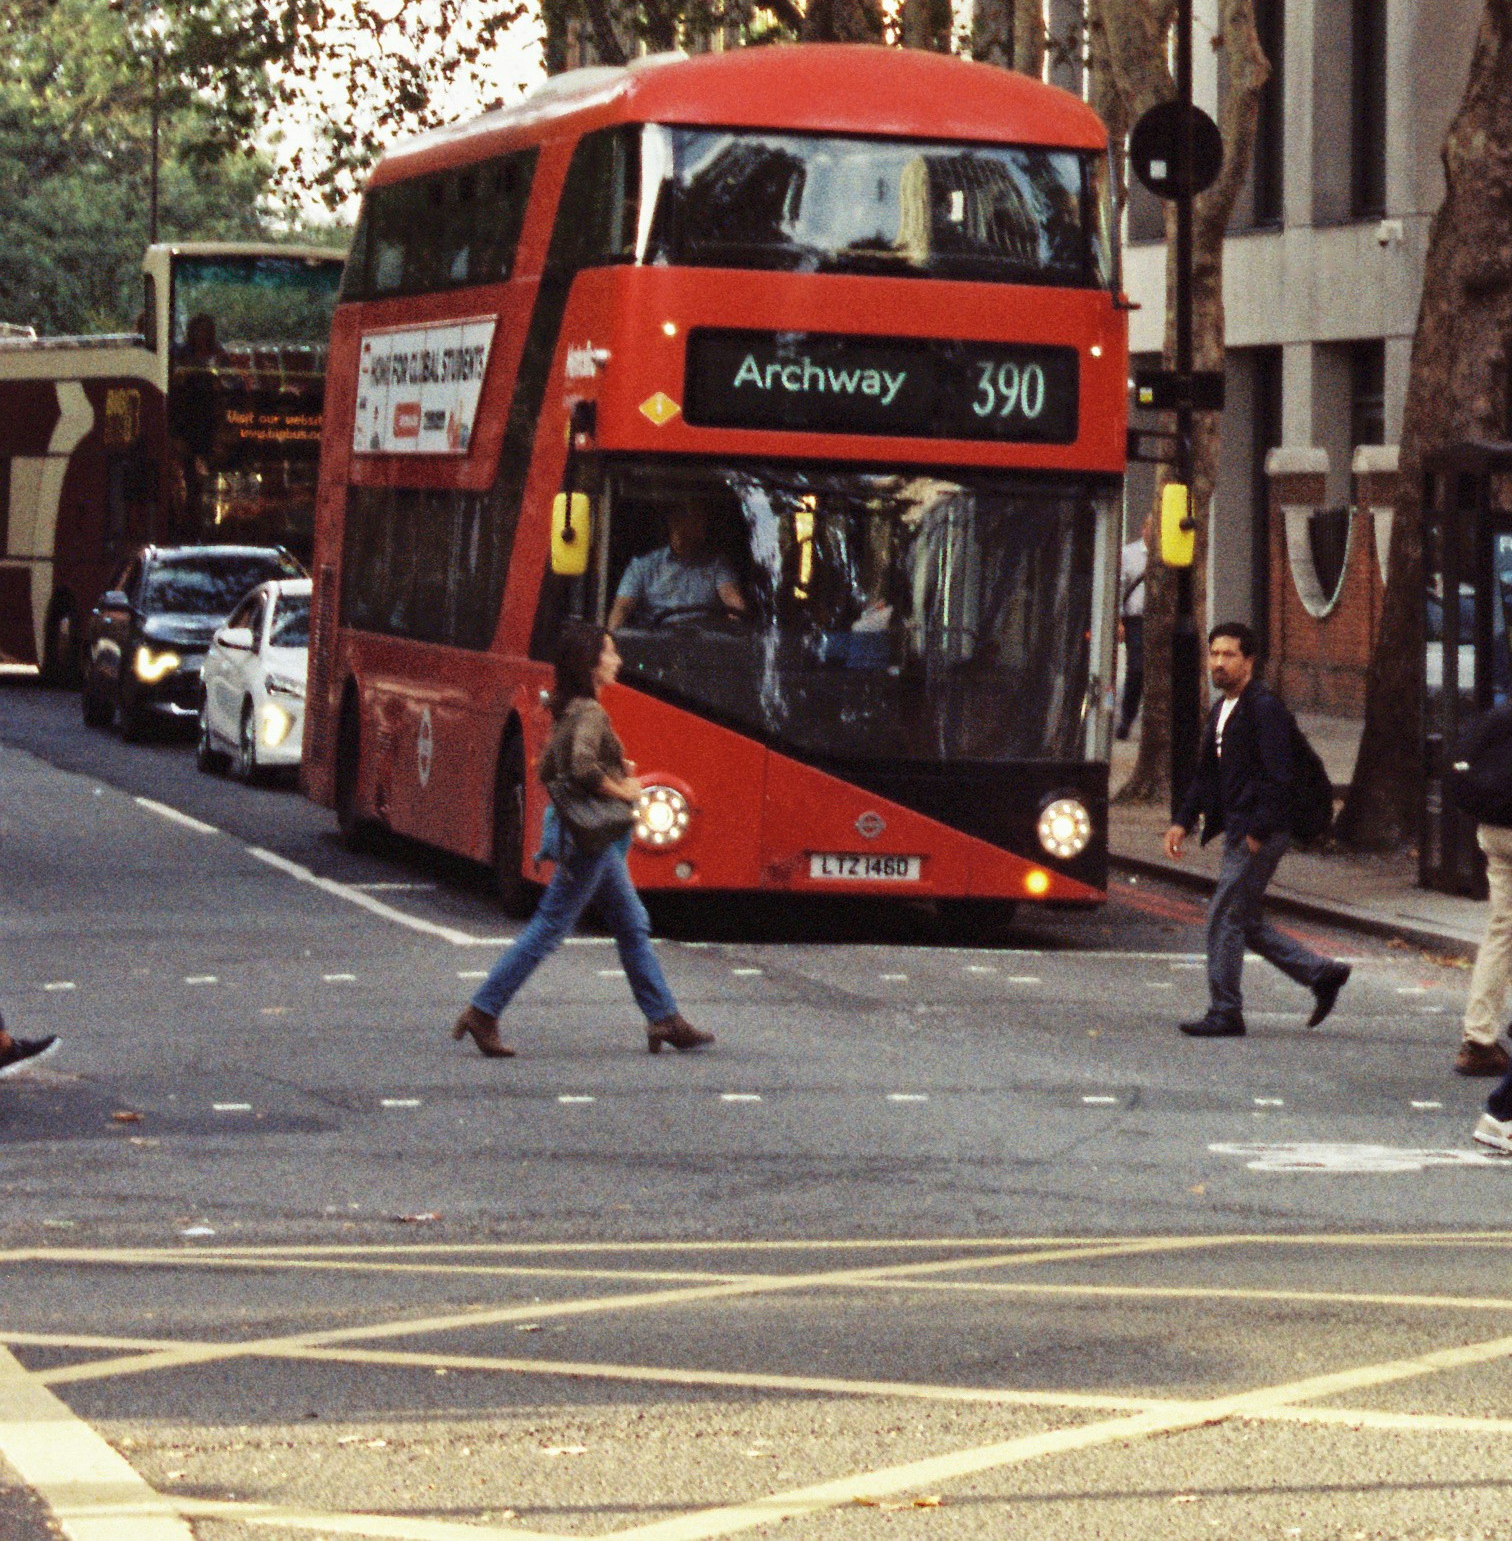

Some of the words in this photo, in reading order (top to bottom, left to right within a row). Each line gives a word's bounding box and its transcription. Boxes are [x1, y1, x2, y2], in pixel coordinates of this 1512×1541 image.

[733, 354, 906, 406] Archway
[972, 361, 1045, 419] 390
[259, 415, 279, 425] our
[285, 413, 323, 426] websit
